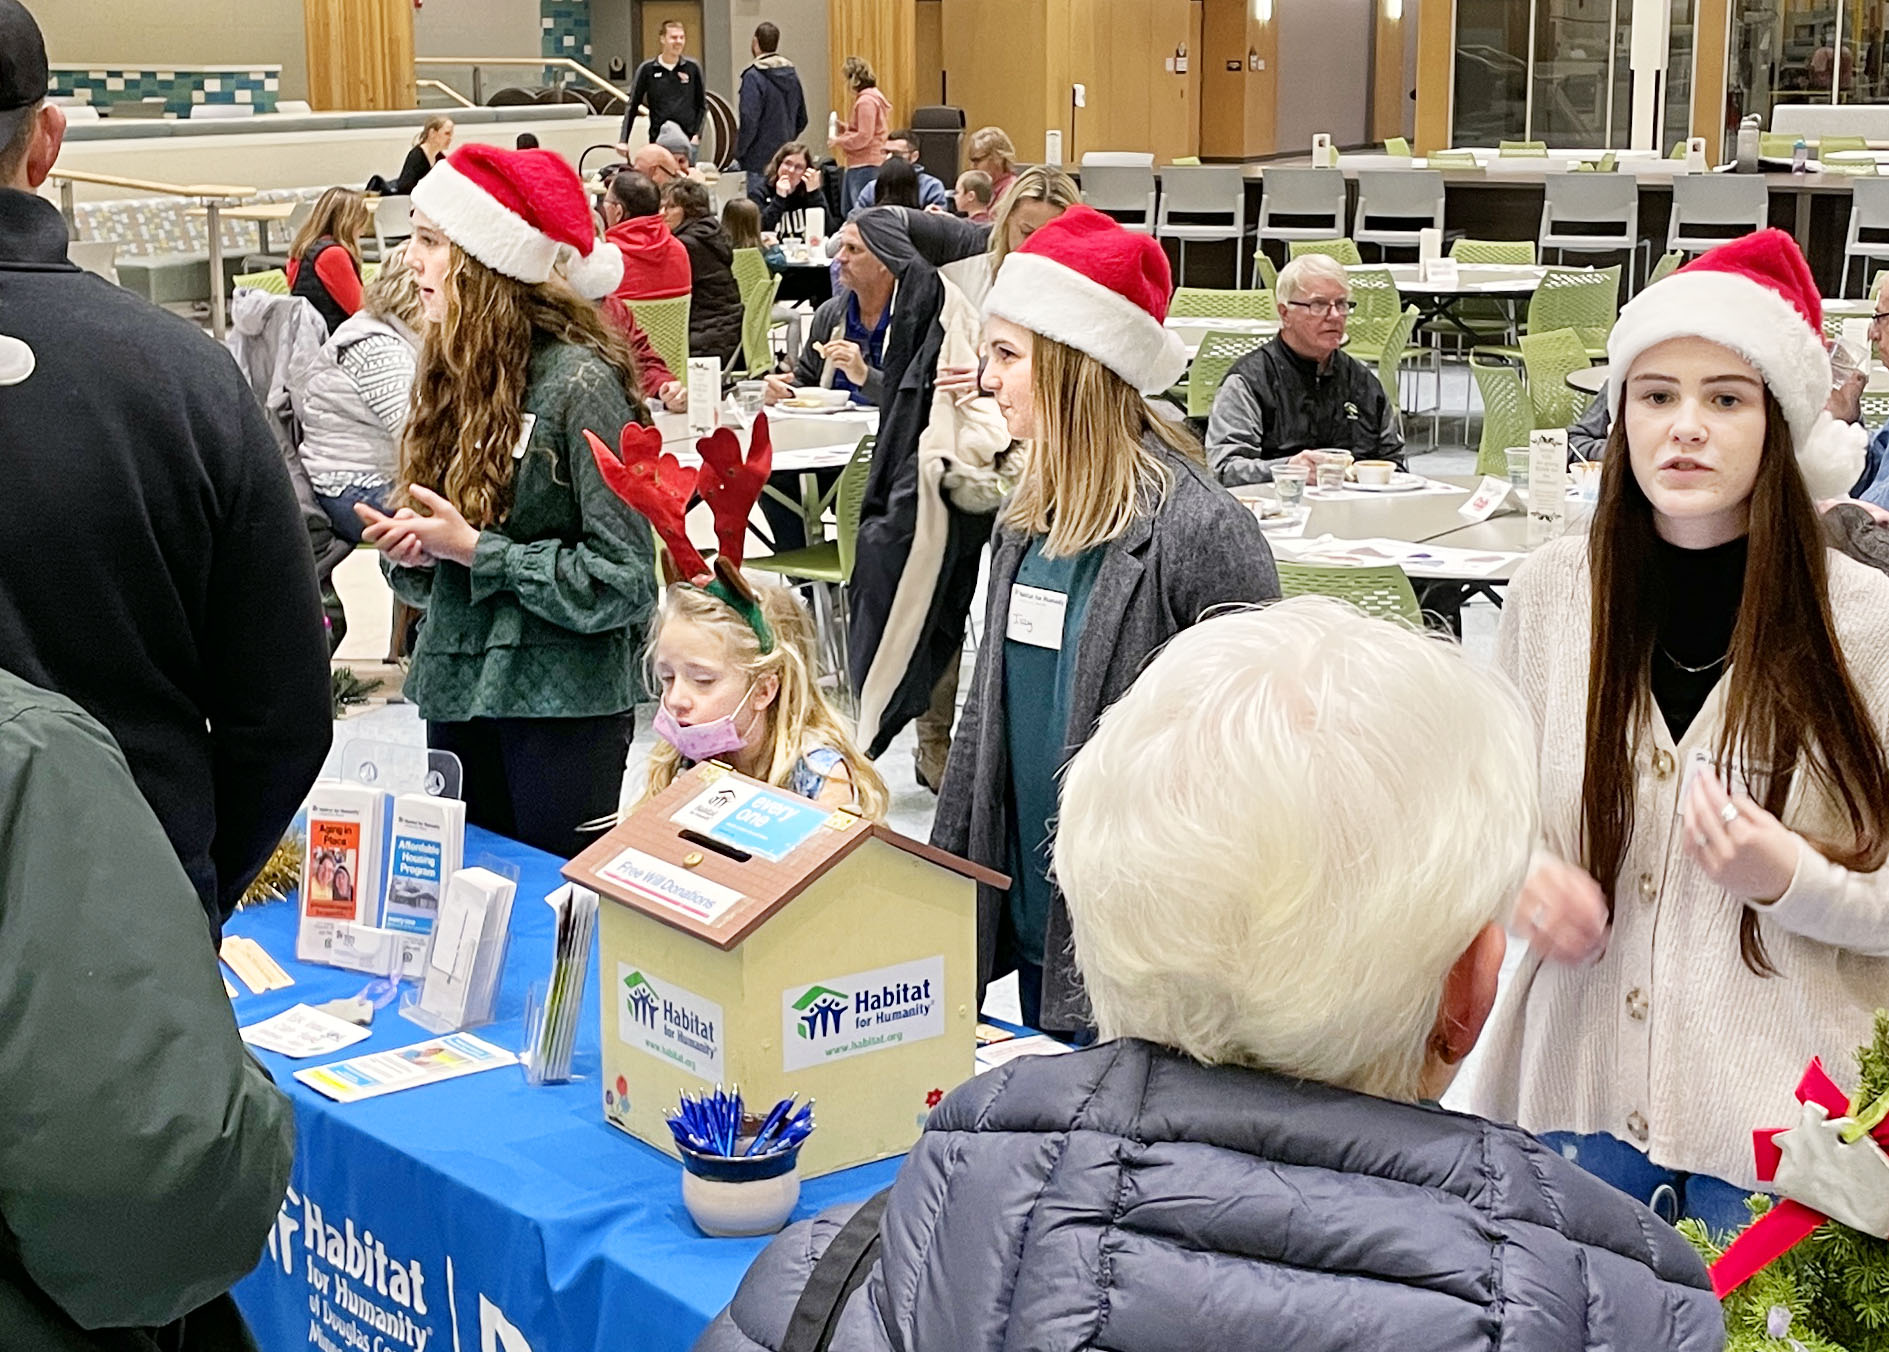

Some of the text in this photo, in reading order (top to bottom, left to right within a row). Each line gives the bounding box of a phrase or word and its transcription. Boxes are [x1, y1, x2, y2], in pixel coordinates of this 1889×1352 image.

[735, 808, 771, 828] one
[751, 796, 800, 823] every
[319, 824, 352, 838] Aging in
[323, 834, 347, 846] Place
[398, 839, 440, 856] Affordable
[401, 851, 436, 868] Housing
[399, 862, 436, 878] Program
[617, 861, 717, 910] Free Will Donations
[855, 979, 931, 1014] Habitat
[663, 999, 714, 1043] Habitat
[855, 1001, 930, 1029] for Humanity
[664, 1023, 714, 1060] for Humanity
[825, 1032, 903, 1056] www.habitat.org
[303, 1194, 427, 1316] Habitat
[307, 1255, 330, 1296] for
[334, 1274, 428, 1352] Humanity
[322, 1300, 370, 1351] Douglas
